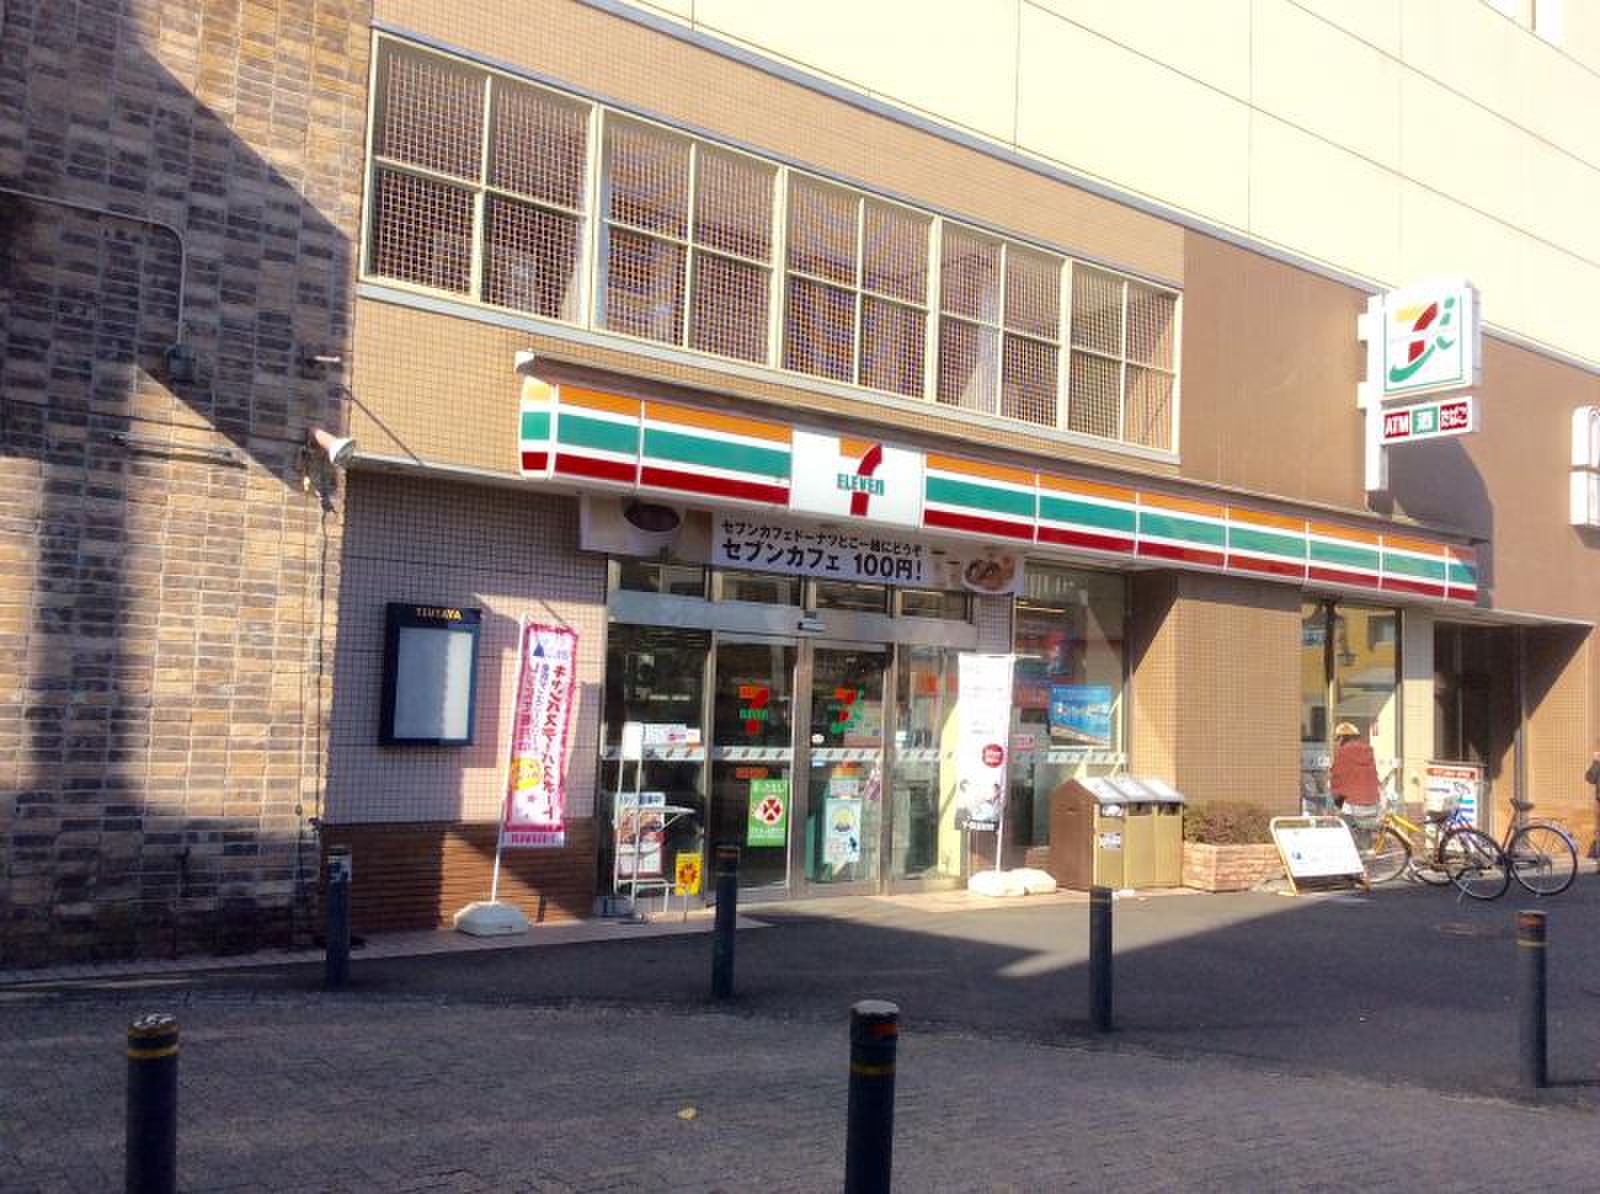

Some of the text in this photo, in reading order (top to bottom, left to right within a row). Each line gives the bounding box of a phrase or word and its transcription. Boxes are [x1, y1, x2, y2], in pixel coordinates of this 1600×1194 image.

[1386, 415, 1409, 435] ATM
[722, 538, 839, 570] セブンカフェ
